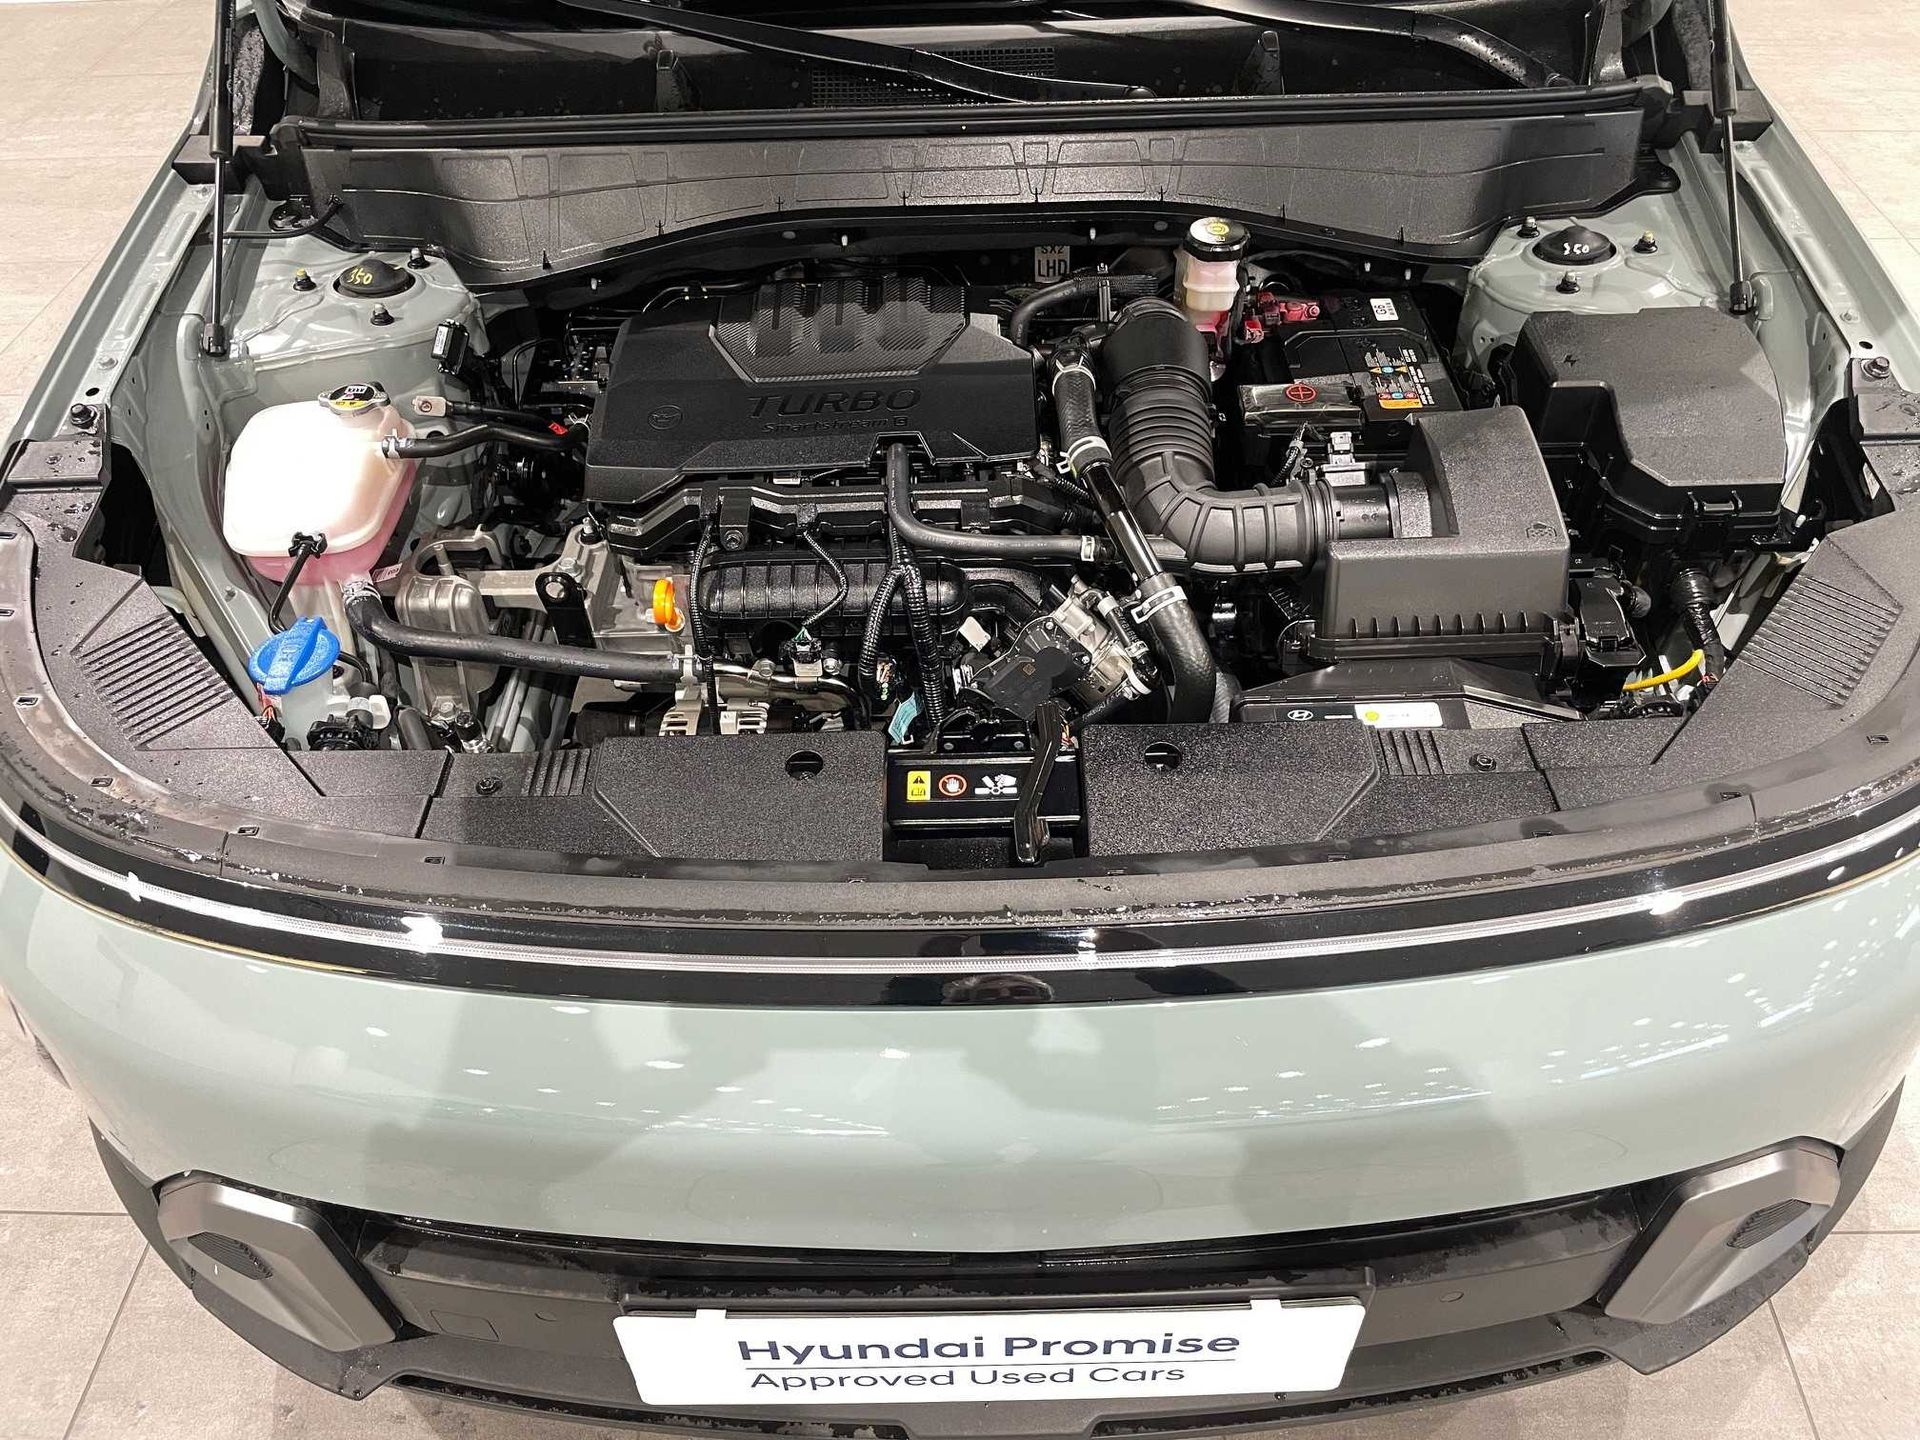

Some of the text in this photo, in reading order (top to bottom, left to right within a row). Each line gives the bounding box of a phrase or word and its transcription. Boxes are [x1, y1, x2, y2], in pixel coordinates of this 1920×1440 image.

[347, 267, 373, 285] 350
[1037, 259, 1067, 278] LHD
[748, 389, 922, 418] TURBO
[763, 418, 889, 433] Smartstream
[737, 1333, 1240, 1365] Hyundai Promise
[750, 1367, 1186, 1391] Approved Used Cars
